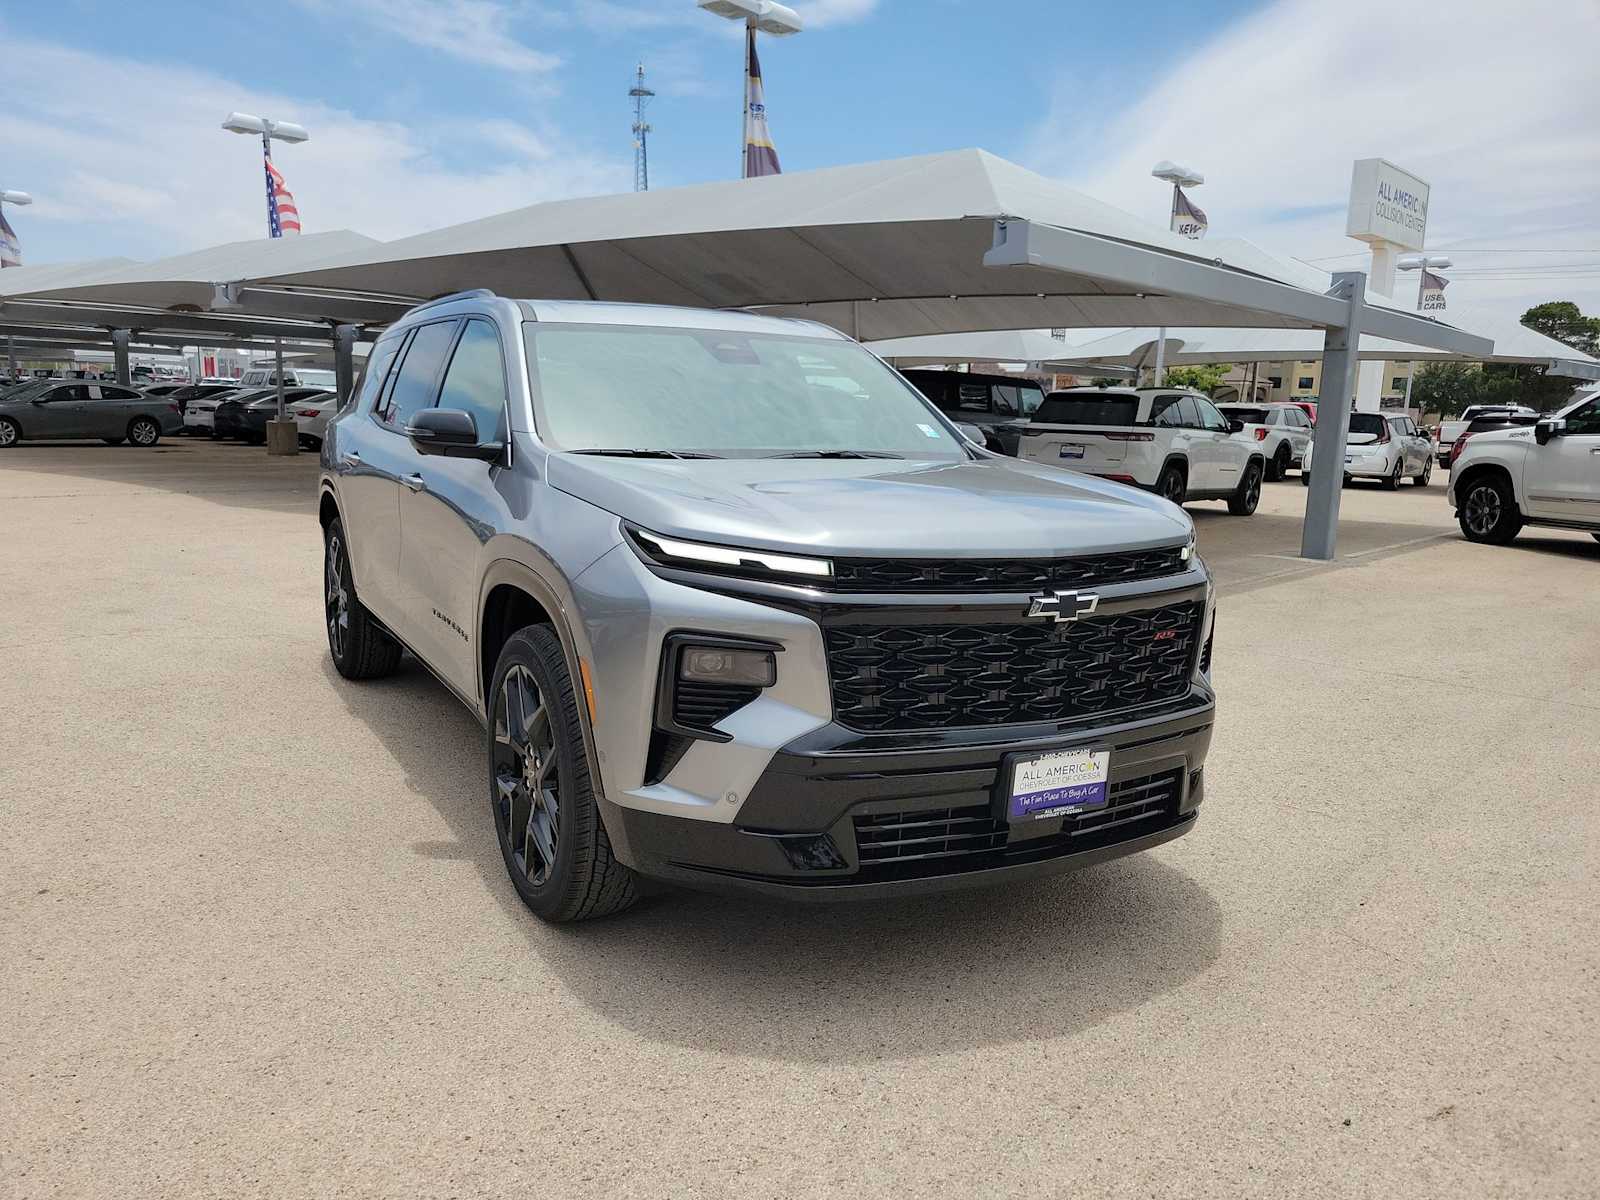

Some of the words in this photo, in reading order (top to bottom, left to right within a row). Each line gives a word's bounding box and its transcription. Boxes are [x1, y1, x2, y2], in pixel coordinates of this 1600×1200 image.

[1378, 181, 1391, 201] ALL
[1393, 188, 1426, 216] AMERICN
[1376, 201, 1403, 224] COLLISION
[1424, 294, 1446, 302] USE
[1424, 302, 1446, 311] CARS
[1023, 769, 1042, 780] ALL
[1046, 761, 1101, 777] AMERICN
[1019, 777, 1060, 790] CHEVROLET
[1061, 775, 1072, 783] OF
[1019, 797, 1030, 806] The
[1031, 794, 1042, 804] Fun
[1043, 791, 1060, 802] Place
[1060, 789, 1068, 799] To
[1069, 788, 1080, 799] Buy
[1081, 787, 1088, 796] A
[1088, 785, 1099, 795] Car
